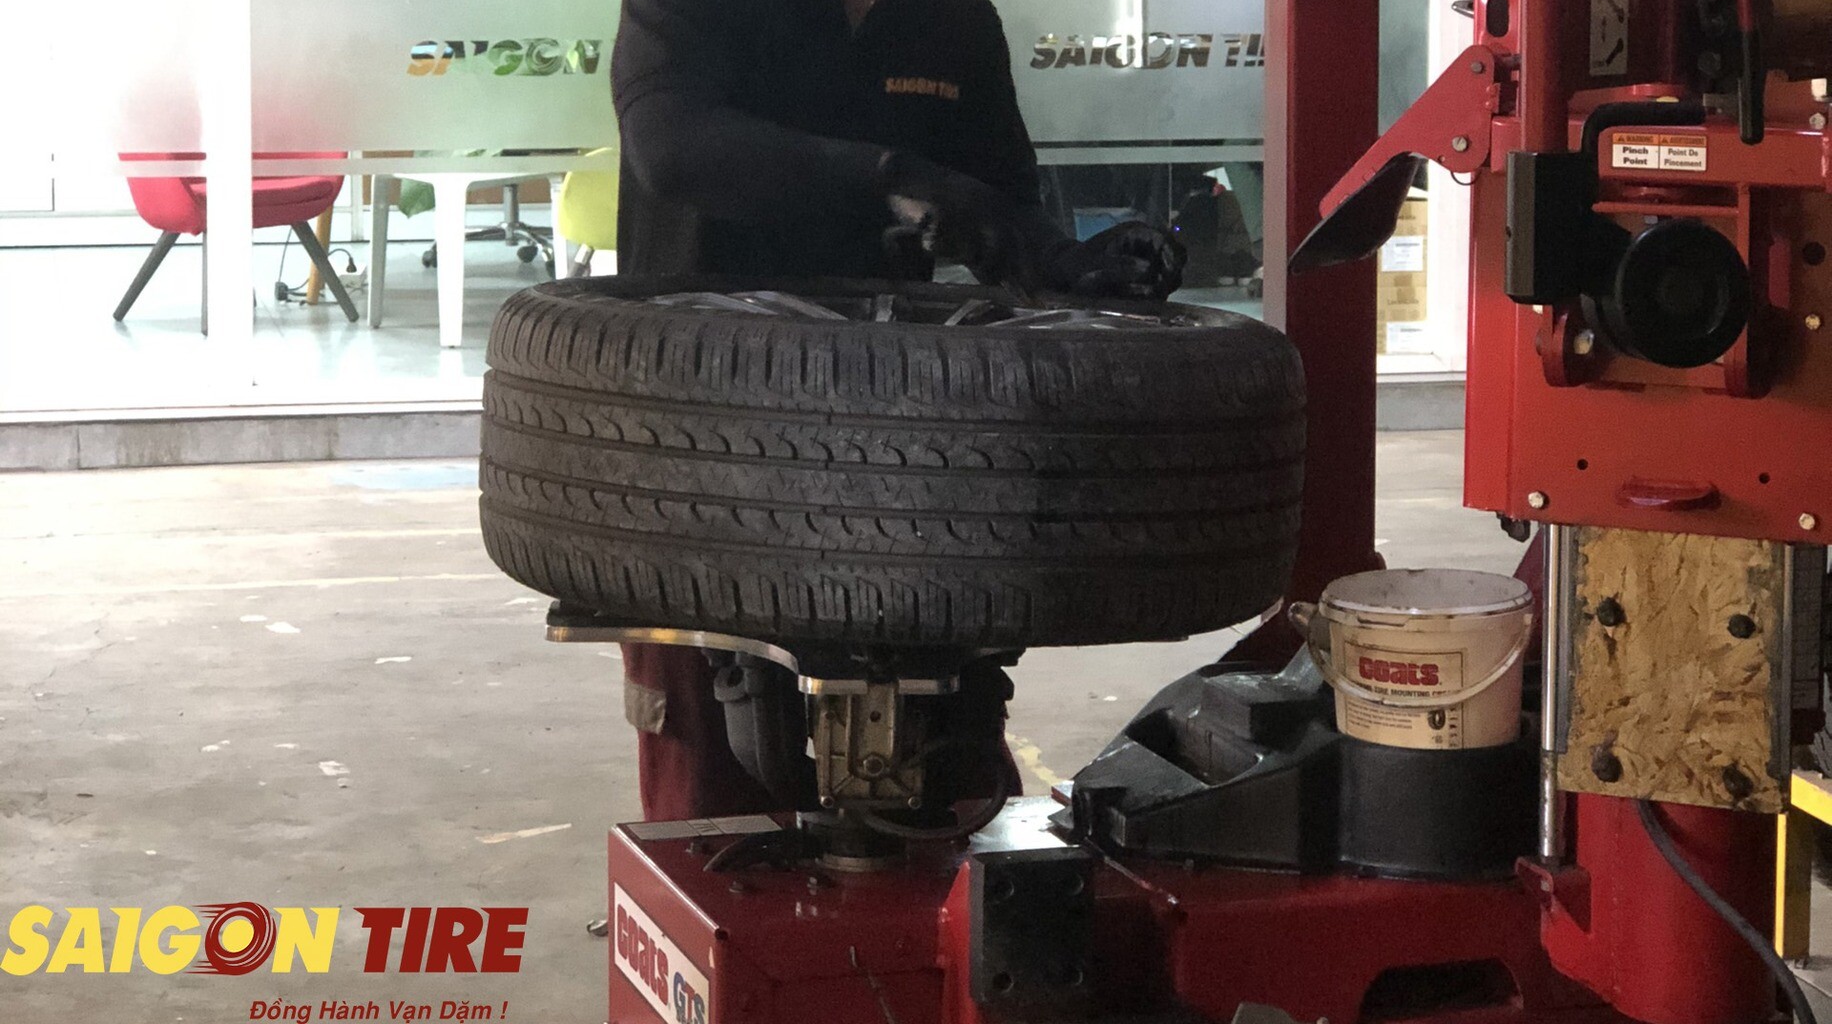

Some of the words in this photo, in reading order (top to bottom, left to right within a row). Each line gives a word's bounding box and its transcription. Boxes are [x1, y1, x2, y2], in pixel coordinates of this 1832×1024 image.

[1030, 32, 1213, 70] SAIGON
[1221, 33, 1265, 67] TI
[1622, 146, 1649, 155] Pinch
[1668, 148, 1687, 157] Point
[1623, 157, 1648, 166] Point
